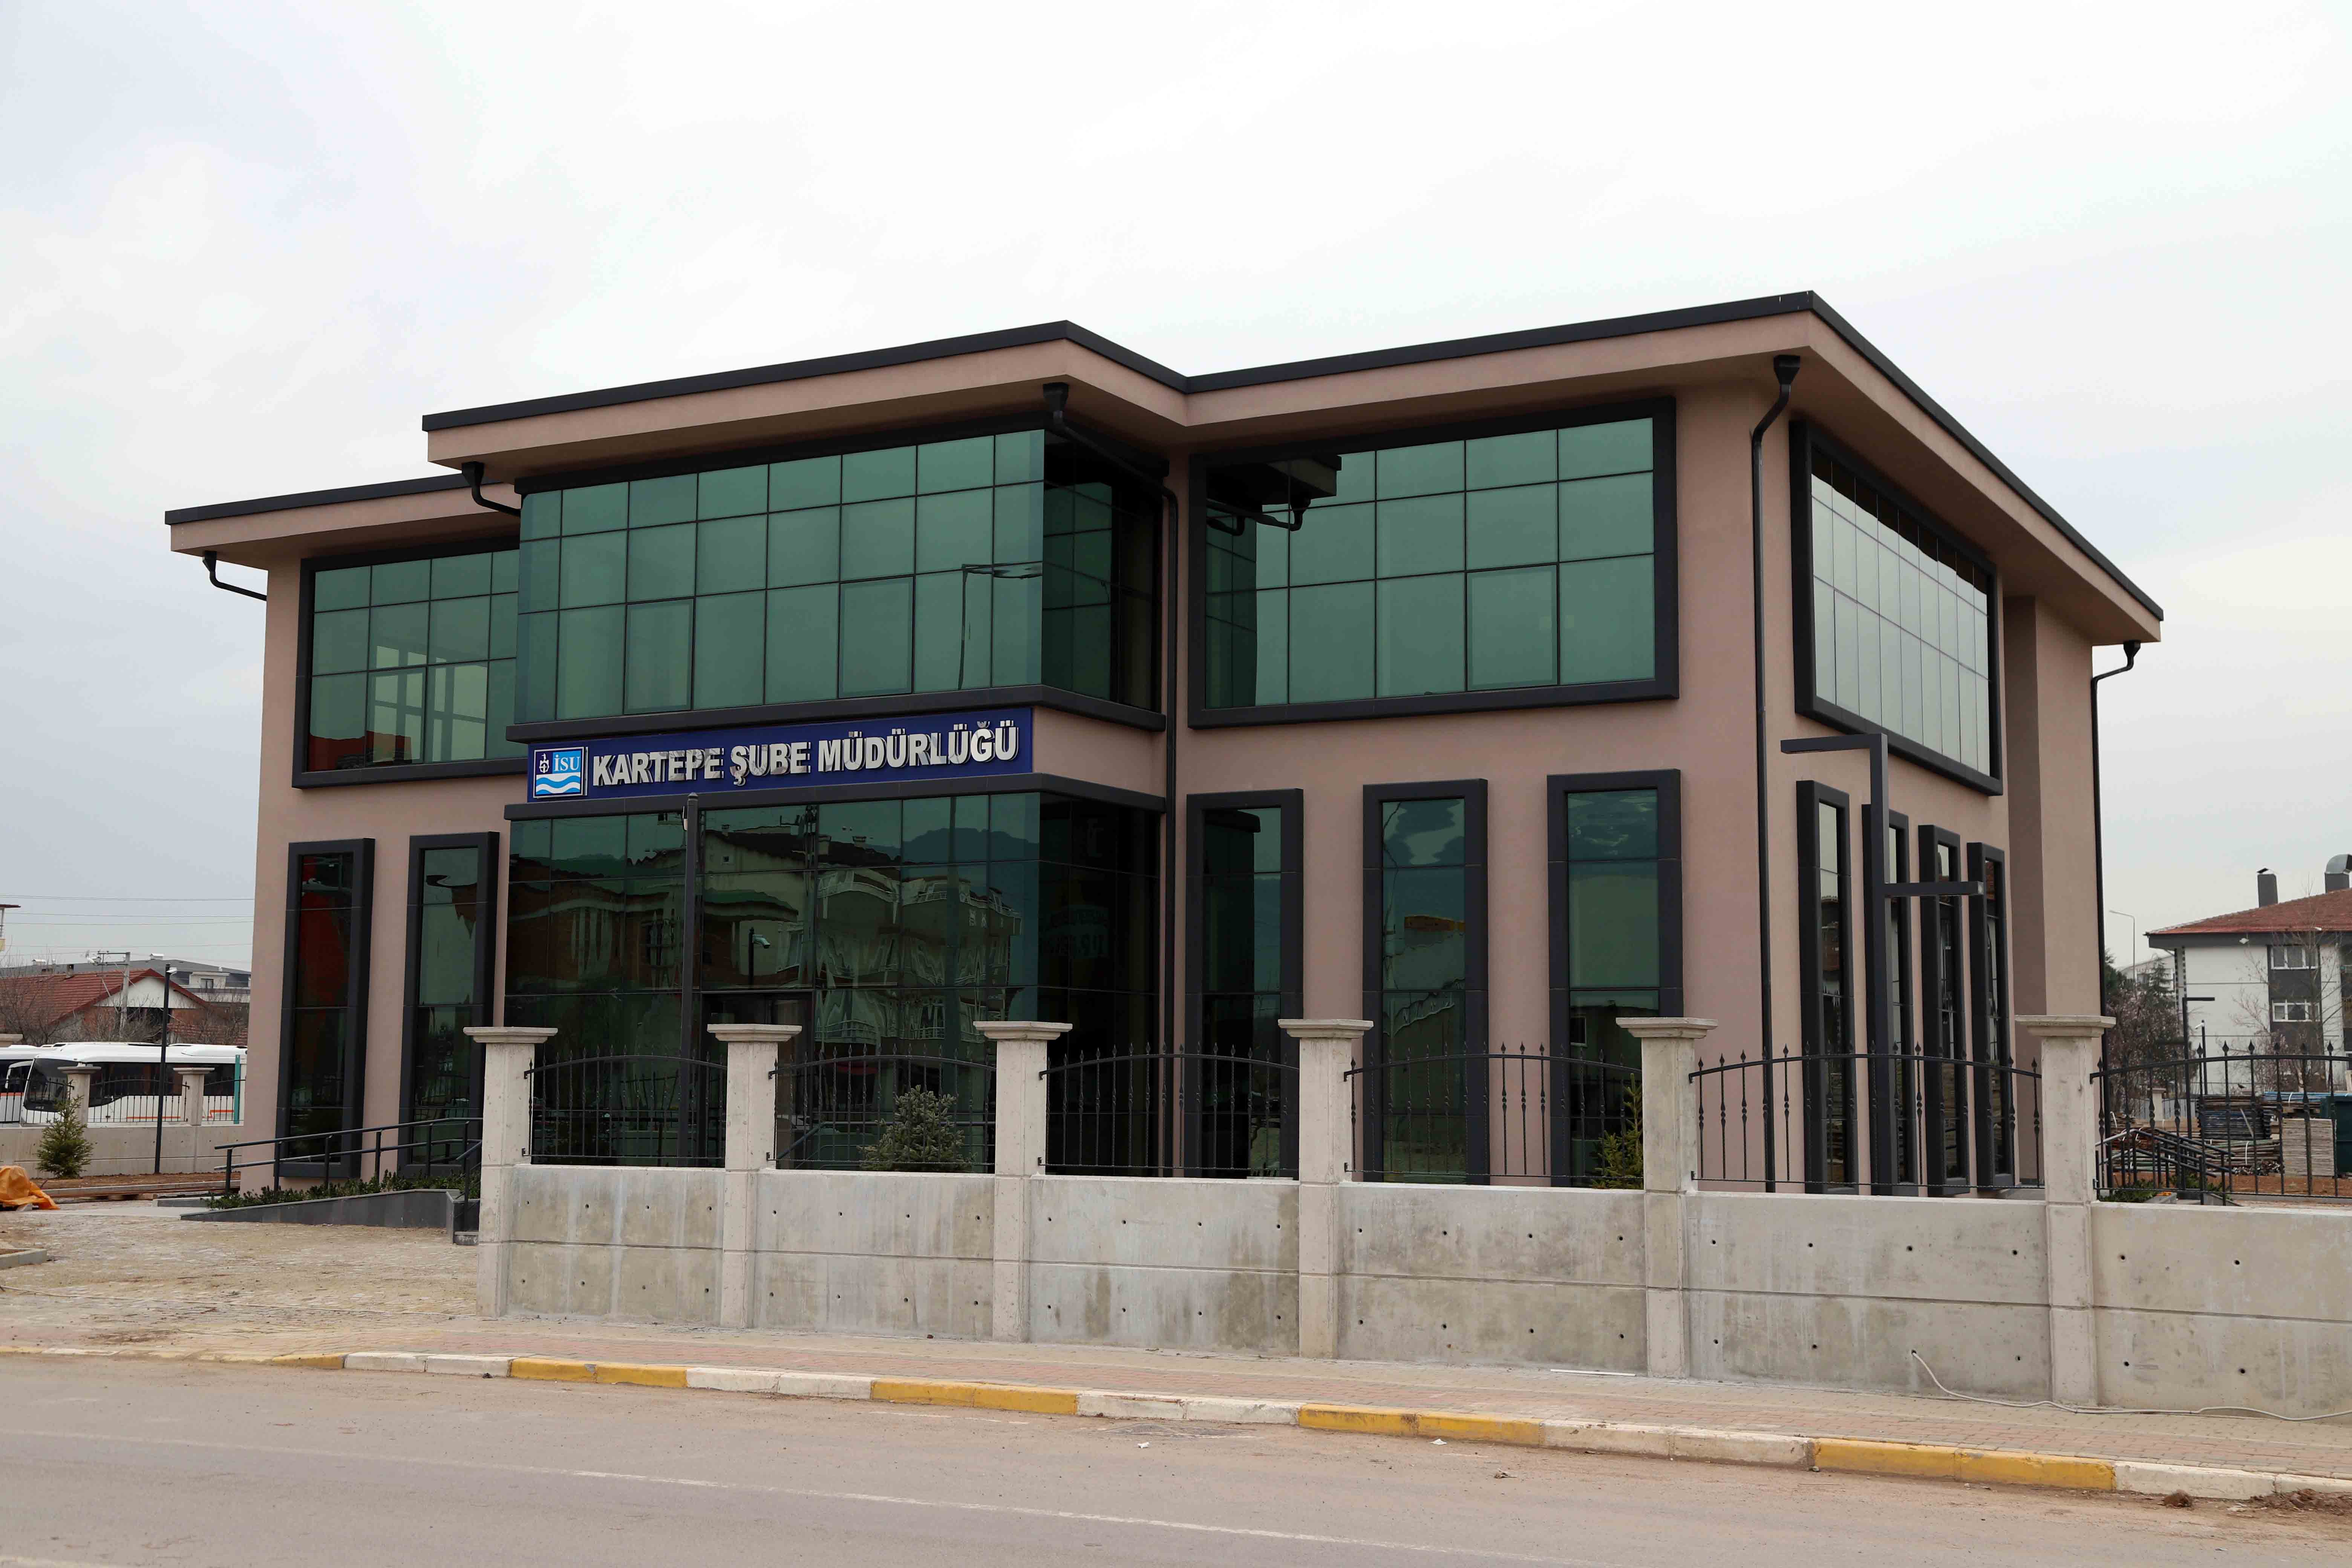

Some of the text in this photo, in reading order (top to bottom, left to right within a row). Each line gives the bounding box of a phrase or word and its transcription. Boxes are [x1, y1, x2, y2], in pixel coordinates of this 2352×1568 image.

[554, 754, 580, 772] İSU
[593, 720, 1018, 786] KARTEPE ŞUBE MÜDÜRLÜĞÜ
